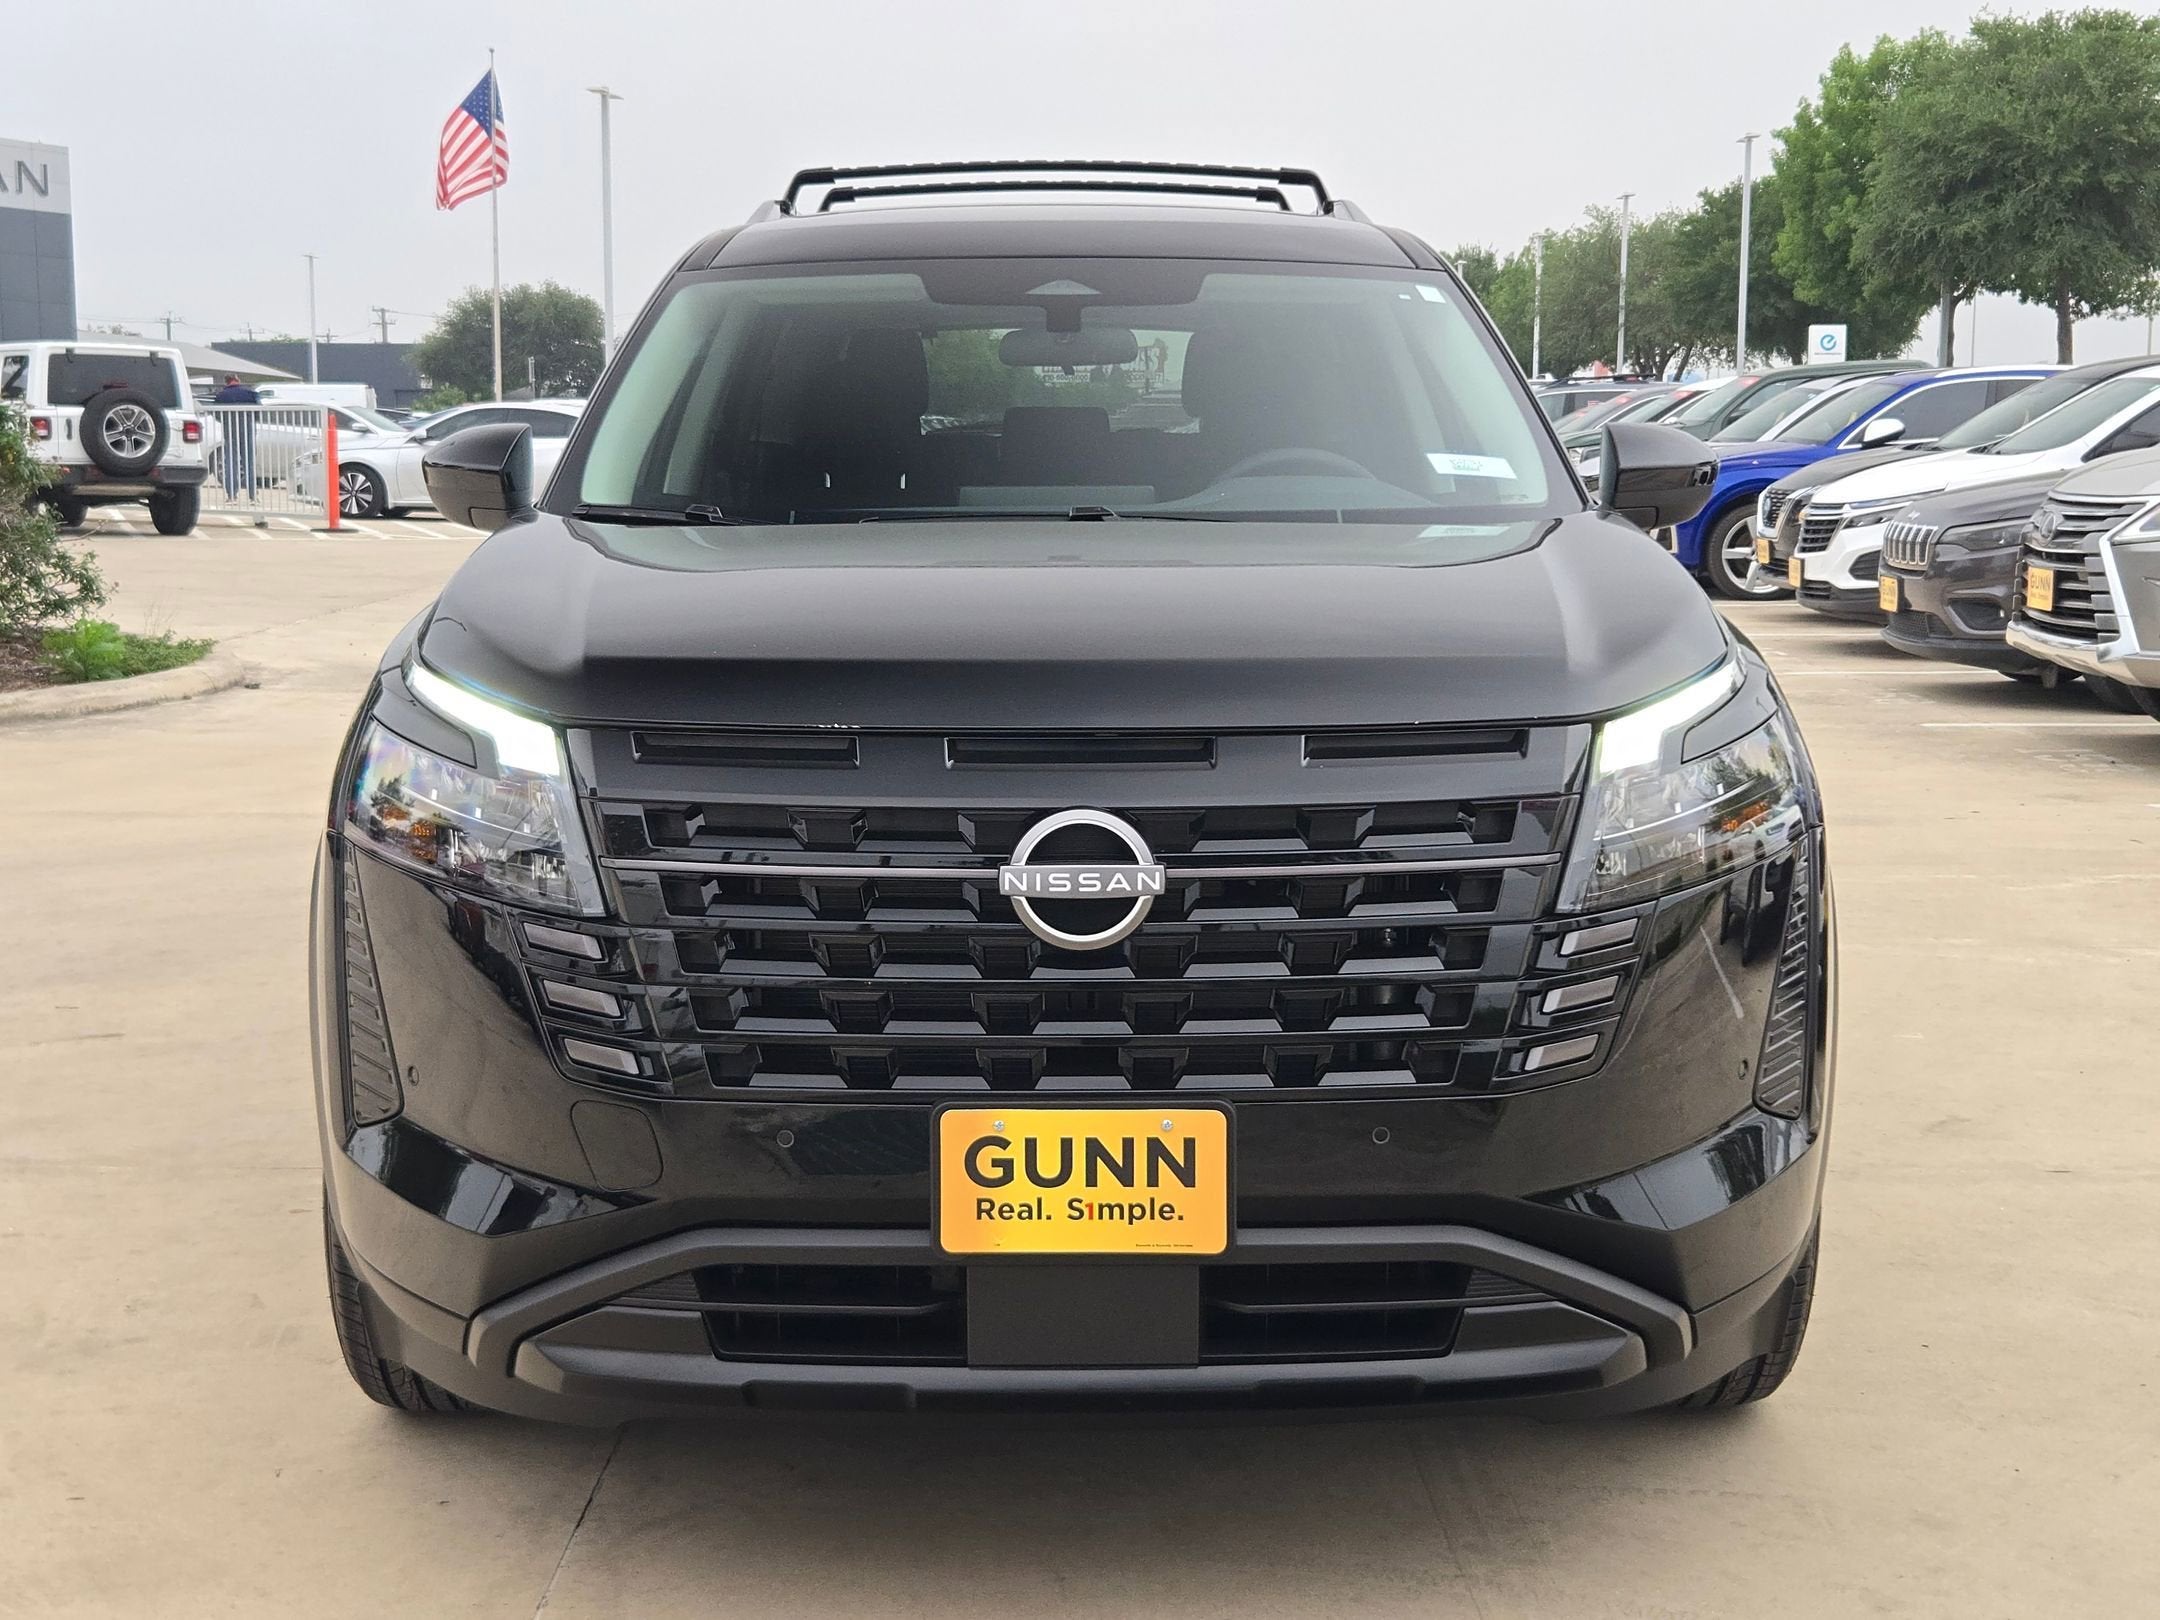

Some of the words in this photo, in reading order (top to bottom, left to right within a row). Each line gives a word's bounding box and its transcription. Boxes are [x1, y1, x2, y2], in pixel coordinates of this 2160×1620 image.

[0, 160, 49, 197] N
[1004, 871, 1160, 892] NISSAN
[964, 1135, 1197, 1189] GUNN
[976, 1197, 1052, 1221] Real.
